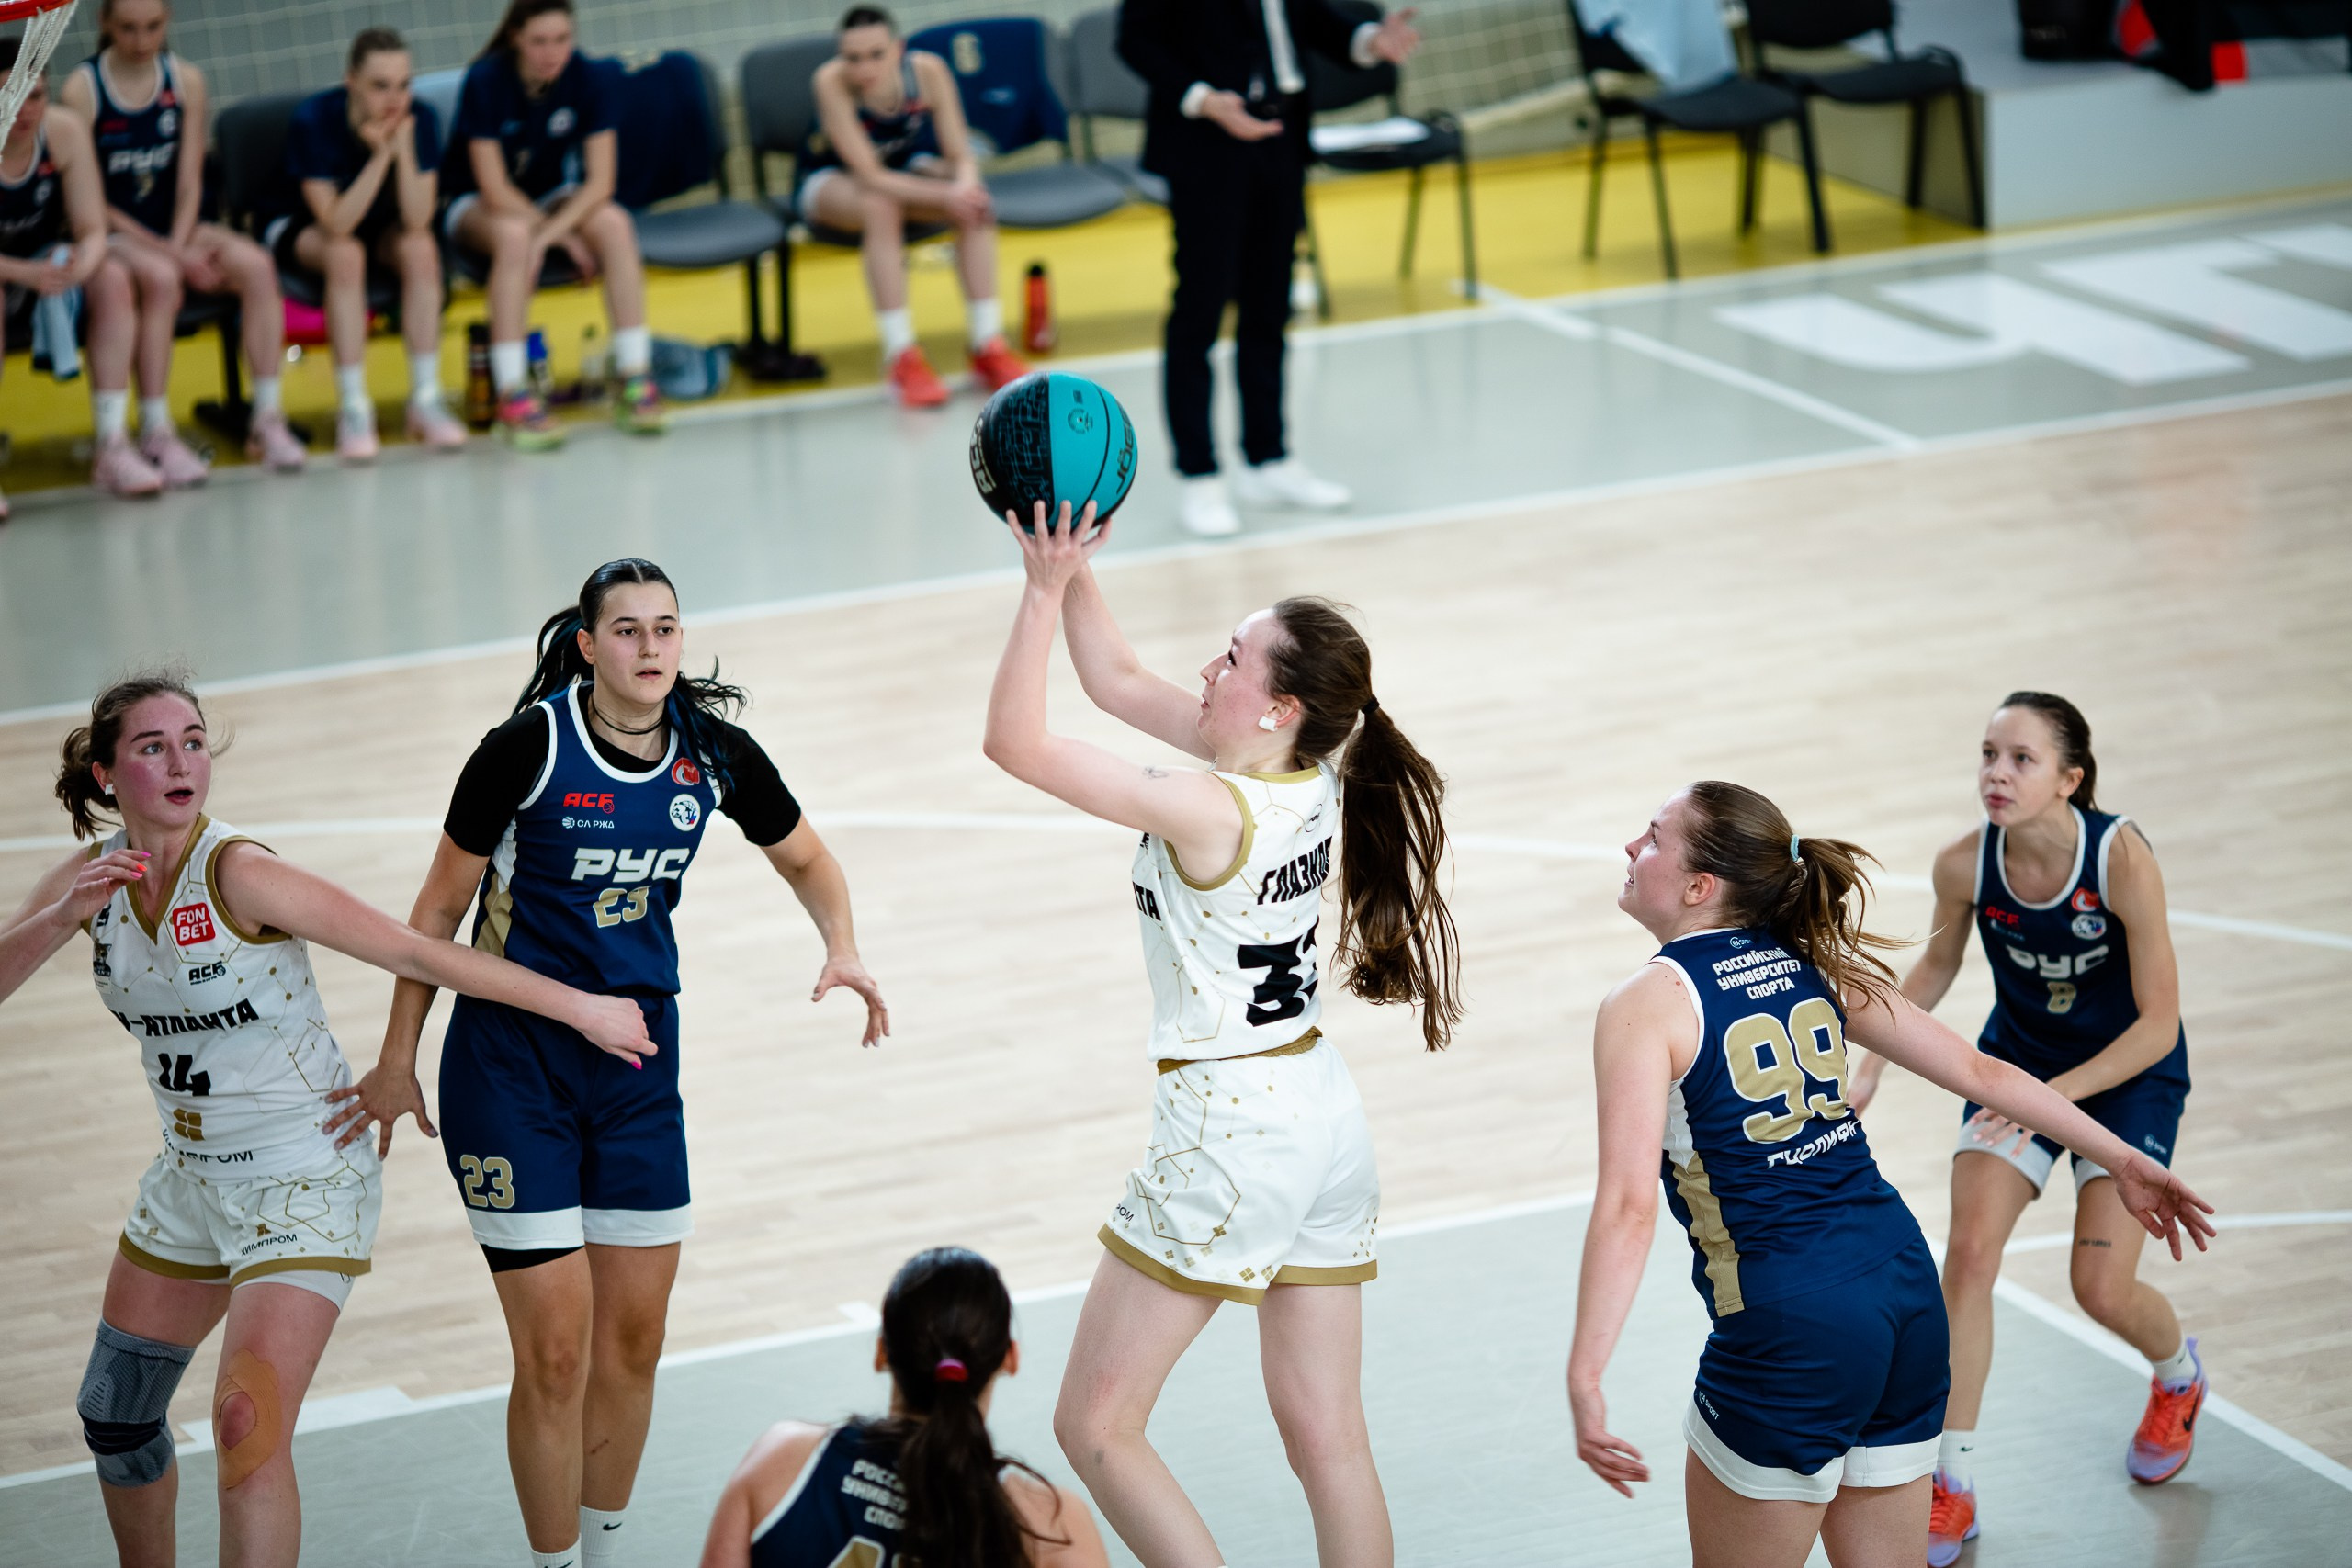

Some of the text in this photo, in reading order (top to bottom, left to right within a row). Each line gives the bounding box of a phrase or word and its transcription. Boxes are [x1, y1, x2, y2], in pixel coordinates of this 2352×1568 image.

[563, 792, 615, 810] АСБ
[571, 847, 690, 883] РУС
[176, 907, 205, 926] FON
[593, 886, 652, 929] 23
[179, 920, 209, 942] BET
[1712, 947, 1791, 976] РОССИЙСКИЙ
[1716, 959, 1801, 991] УНИВЕРСИТЕТ
[2005, 944, 2109, 979] РУС
[1746, 976, 1795, 1000] СПОРТА
[157, 1053, 211, 1096] 14
[1723, 997, 1850, 1144] 99
[1767, 1120, 1860, 1169] ГЦОЛИФК
[460, 1154, 515, 1209] 23
[241, 1234, 298, 1257] ХИМПРОМ
[841, 1474, 907, 1513] УНИВ
